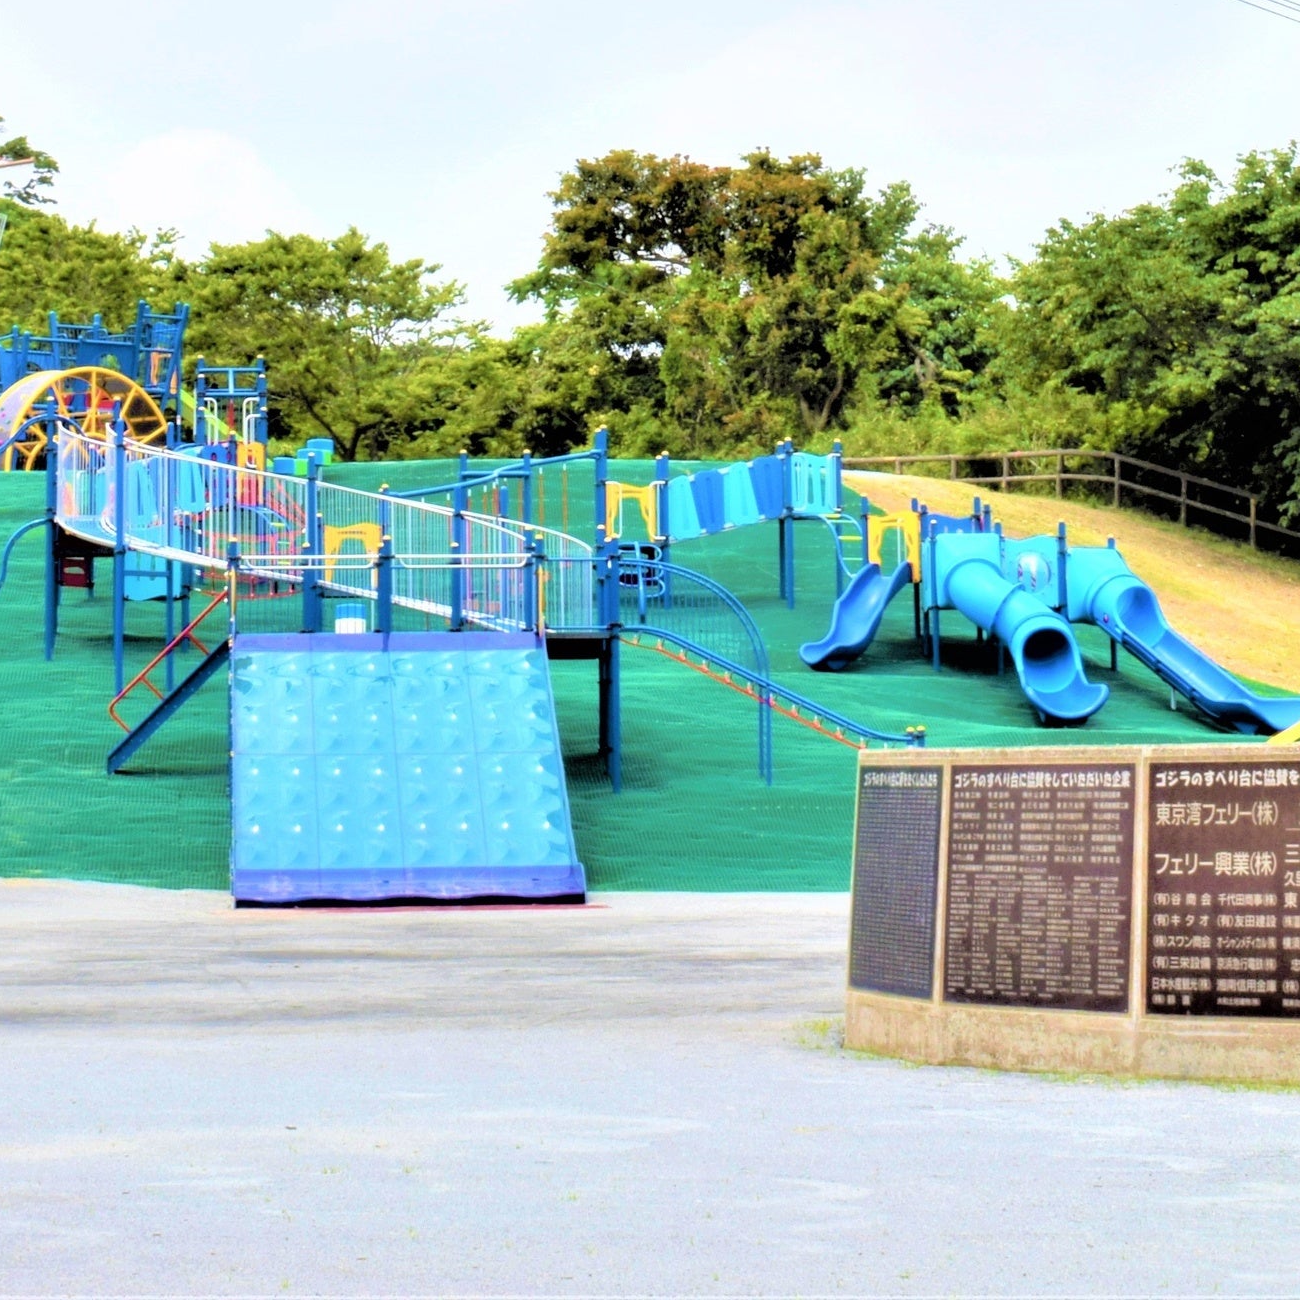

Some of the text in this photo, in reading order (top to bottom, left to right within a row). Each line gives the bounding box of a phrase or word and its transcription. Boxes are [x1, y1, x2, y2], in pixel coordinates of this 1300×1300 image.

[954, 771, 1131, 788] ゴジラのすべり台に協賛をしていただいた企業
[1155, 801, 1279, 826] 東京湾フェリー(株)
